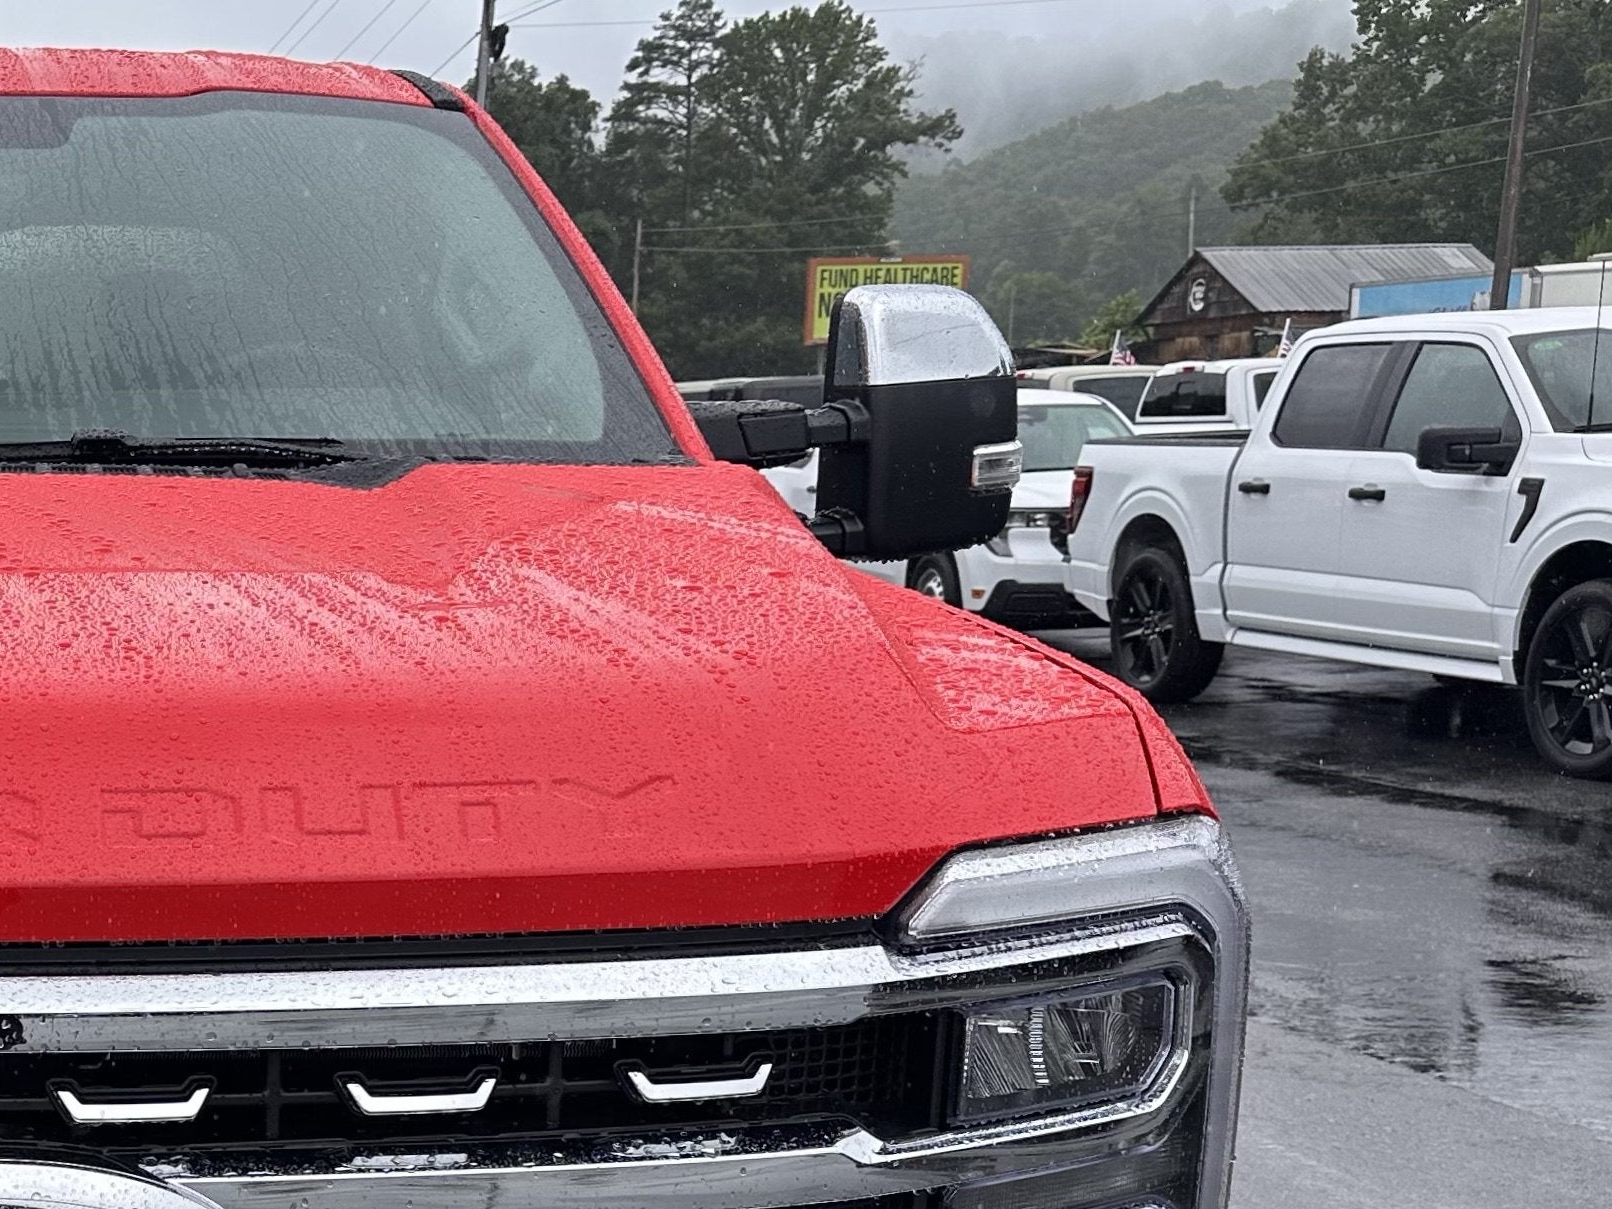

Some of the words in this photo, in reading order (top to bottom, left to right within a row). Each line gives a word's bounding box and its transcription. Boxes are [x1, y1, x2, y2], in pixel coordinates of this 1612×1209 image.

[819, 268, 859, 289] FUND
[863, 266, 959, 286] HEALTHCARE
[99, 775, 677, 848] DUTY
